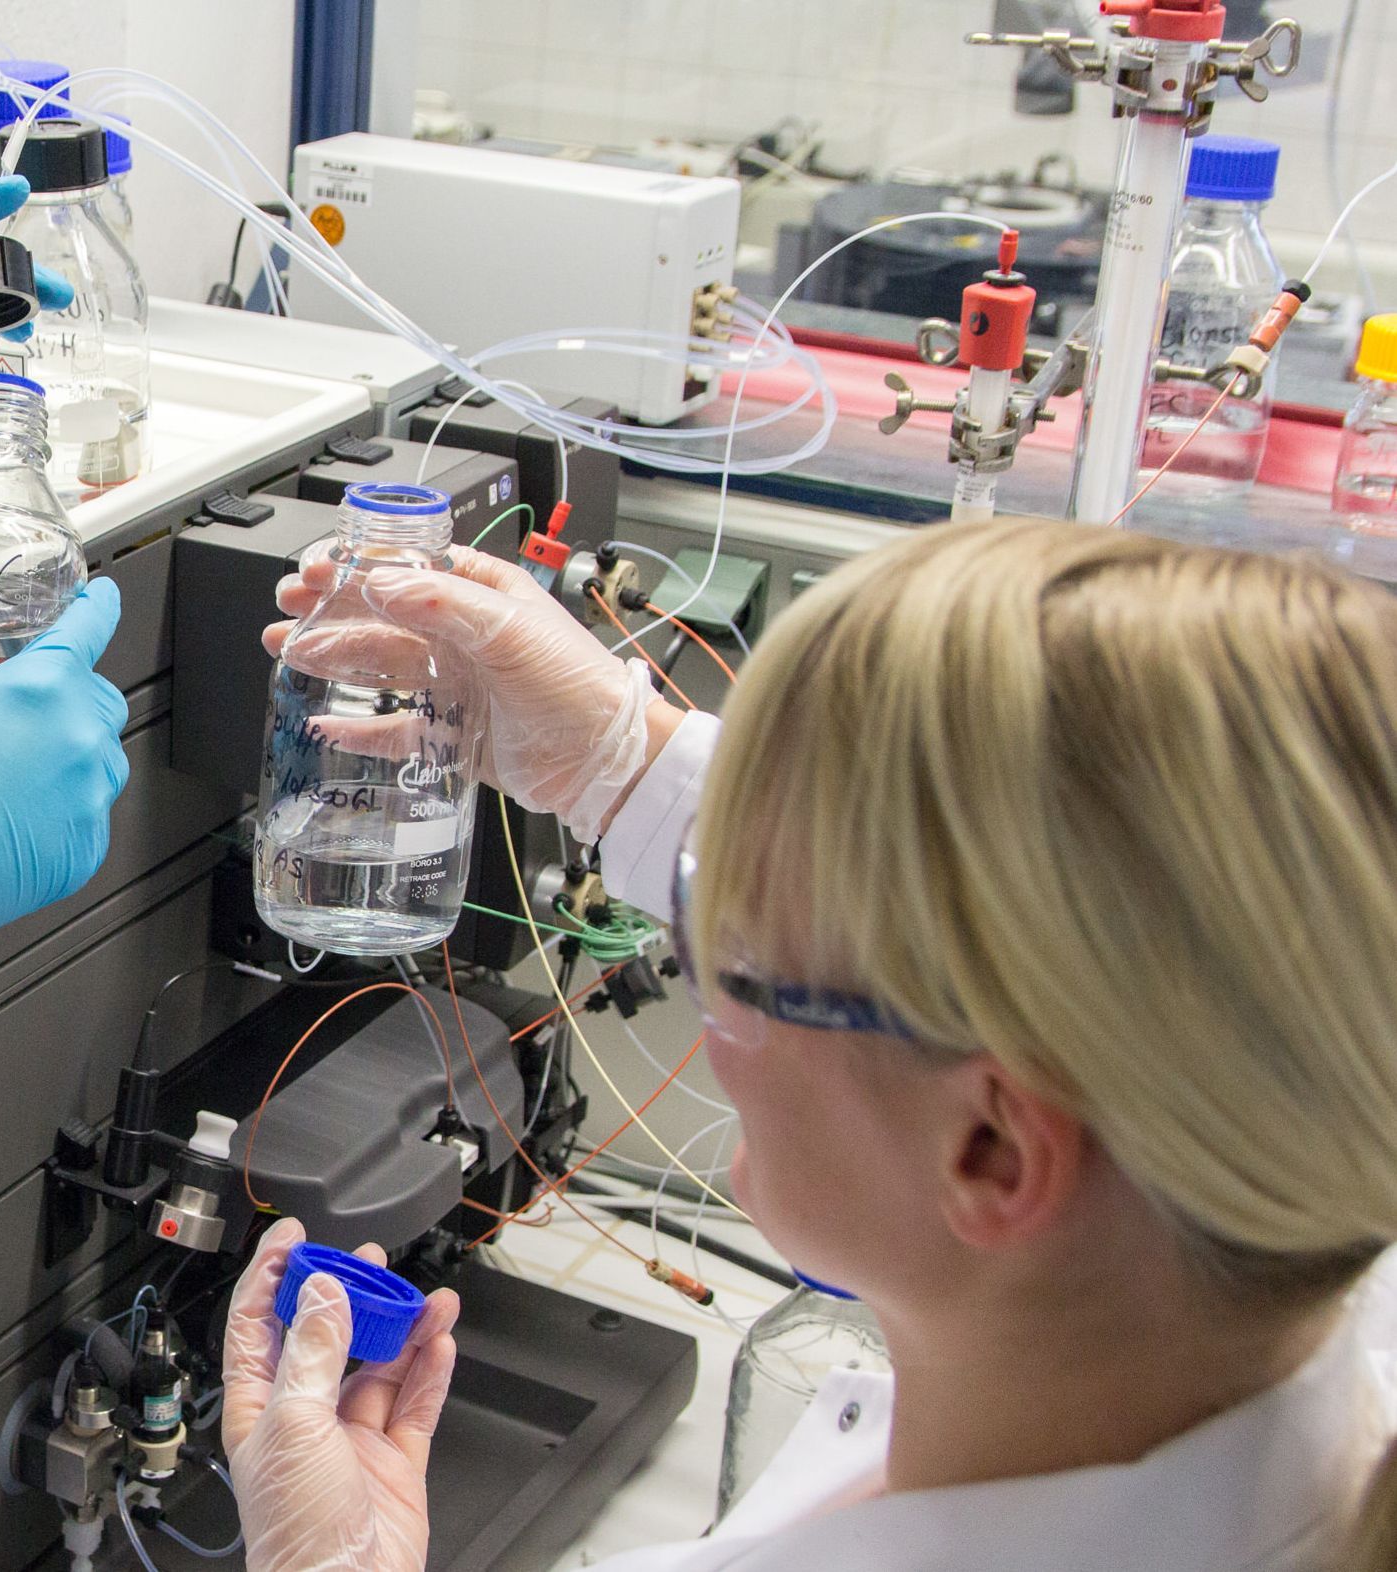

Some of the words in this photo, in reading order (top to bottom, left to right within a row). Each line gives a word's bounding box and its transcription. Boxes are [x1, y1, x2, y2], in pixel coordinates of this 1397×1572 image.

[410, 801, 436, 817] 500
[410, 858, 433, 868] BORO
[399, 873, 430, 883] RETRACE
[431, 870, 447, 880] CODE
